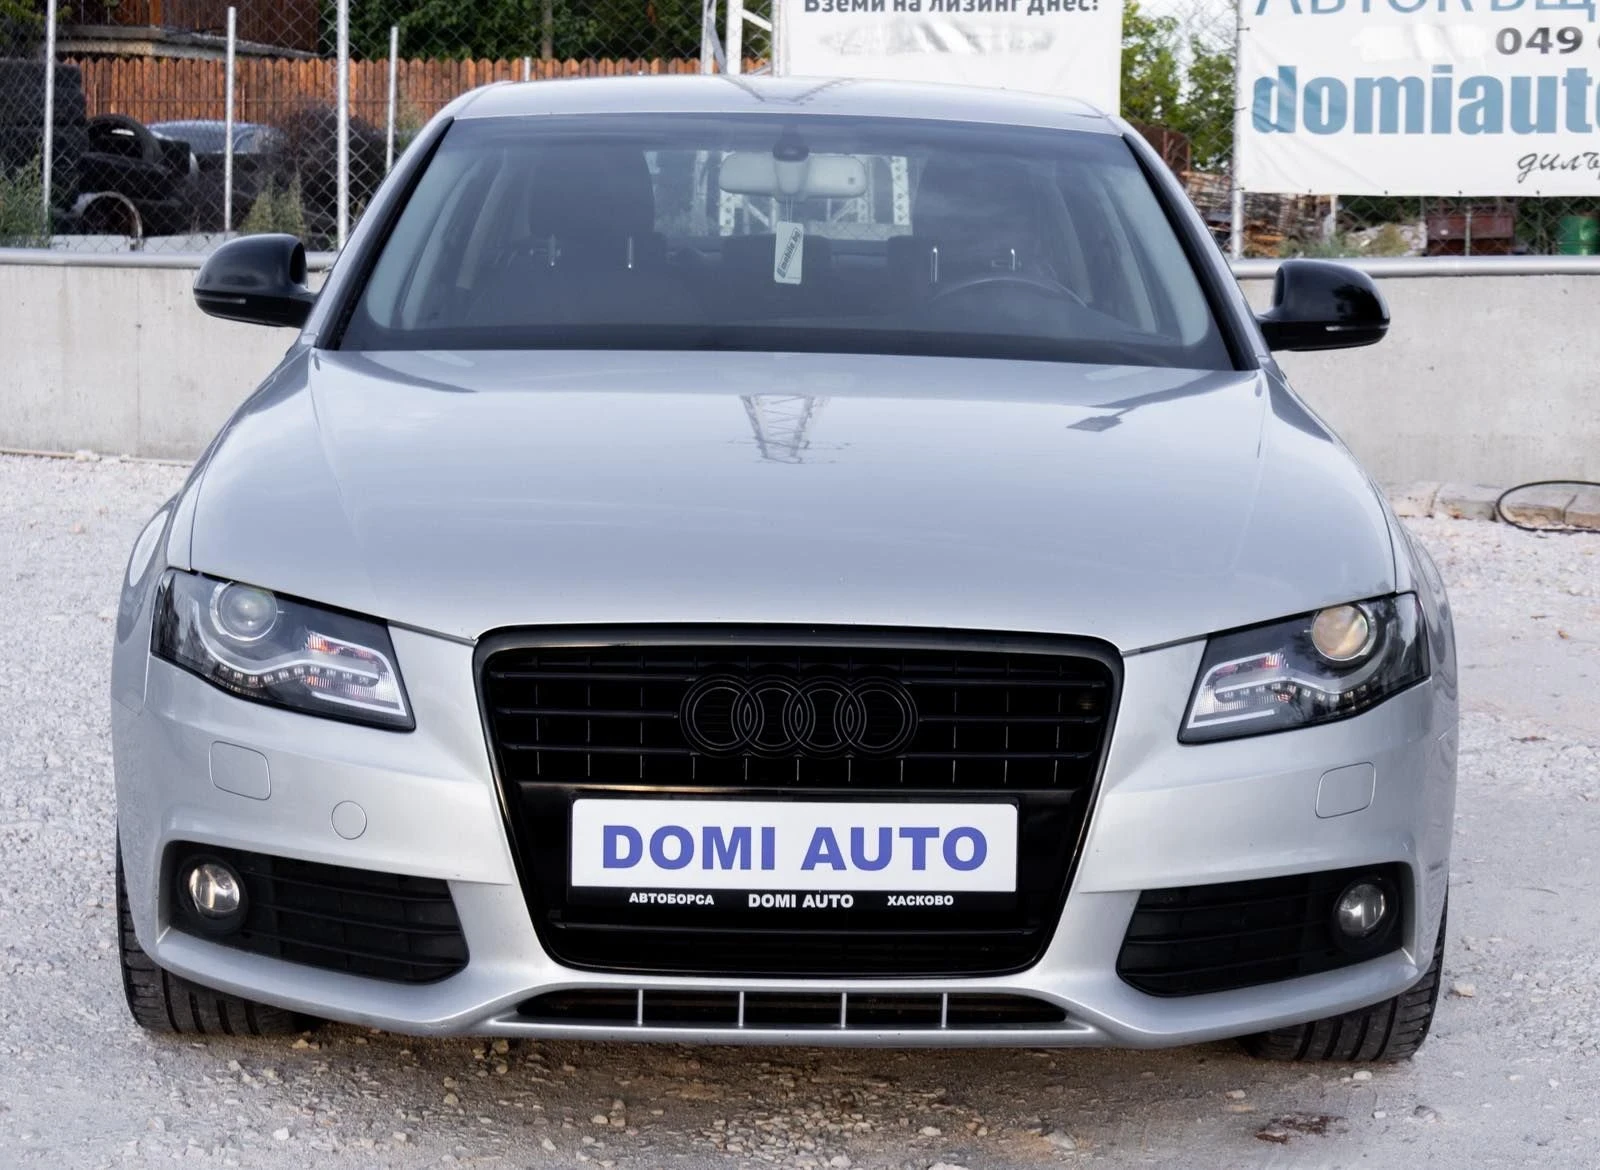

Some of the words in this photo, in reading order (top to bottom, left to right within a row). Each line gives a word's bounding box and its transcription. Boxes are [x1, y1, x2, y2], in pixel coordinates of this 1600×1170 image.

[893, 0, 922, 12] на
[1495, 26, 1584, 56] 049
[1250, 64, 1600, 136] domiaut
[1516, 151, 1600, 184] дилъ
[602, 825, 776, 870] DOMI
[800, 826, 988, 872] AUTO
[628, 892, 715, 906] АВТОБОРСА
[748, 894, 797, 908] DOMI
[802, 895, 854, 909] AUTO
[887, 895, 955, 907] ХАСКОВО
